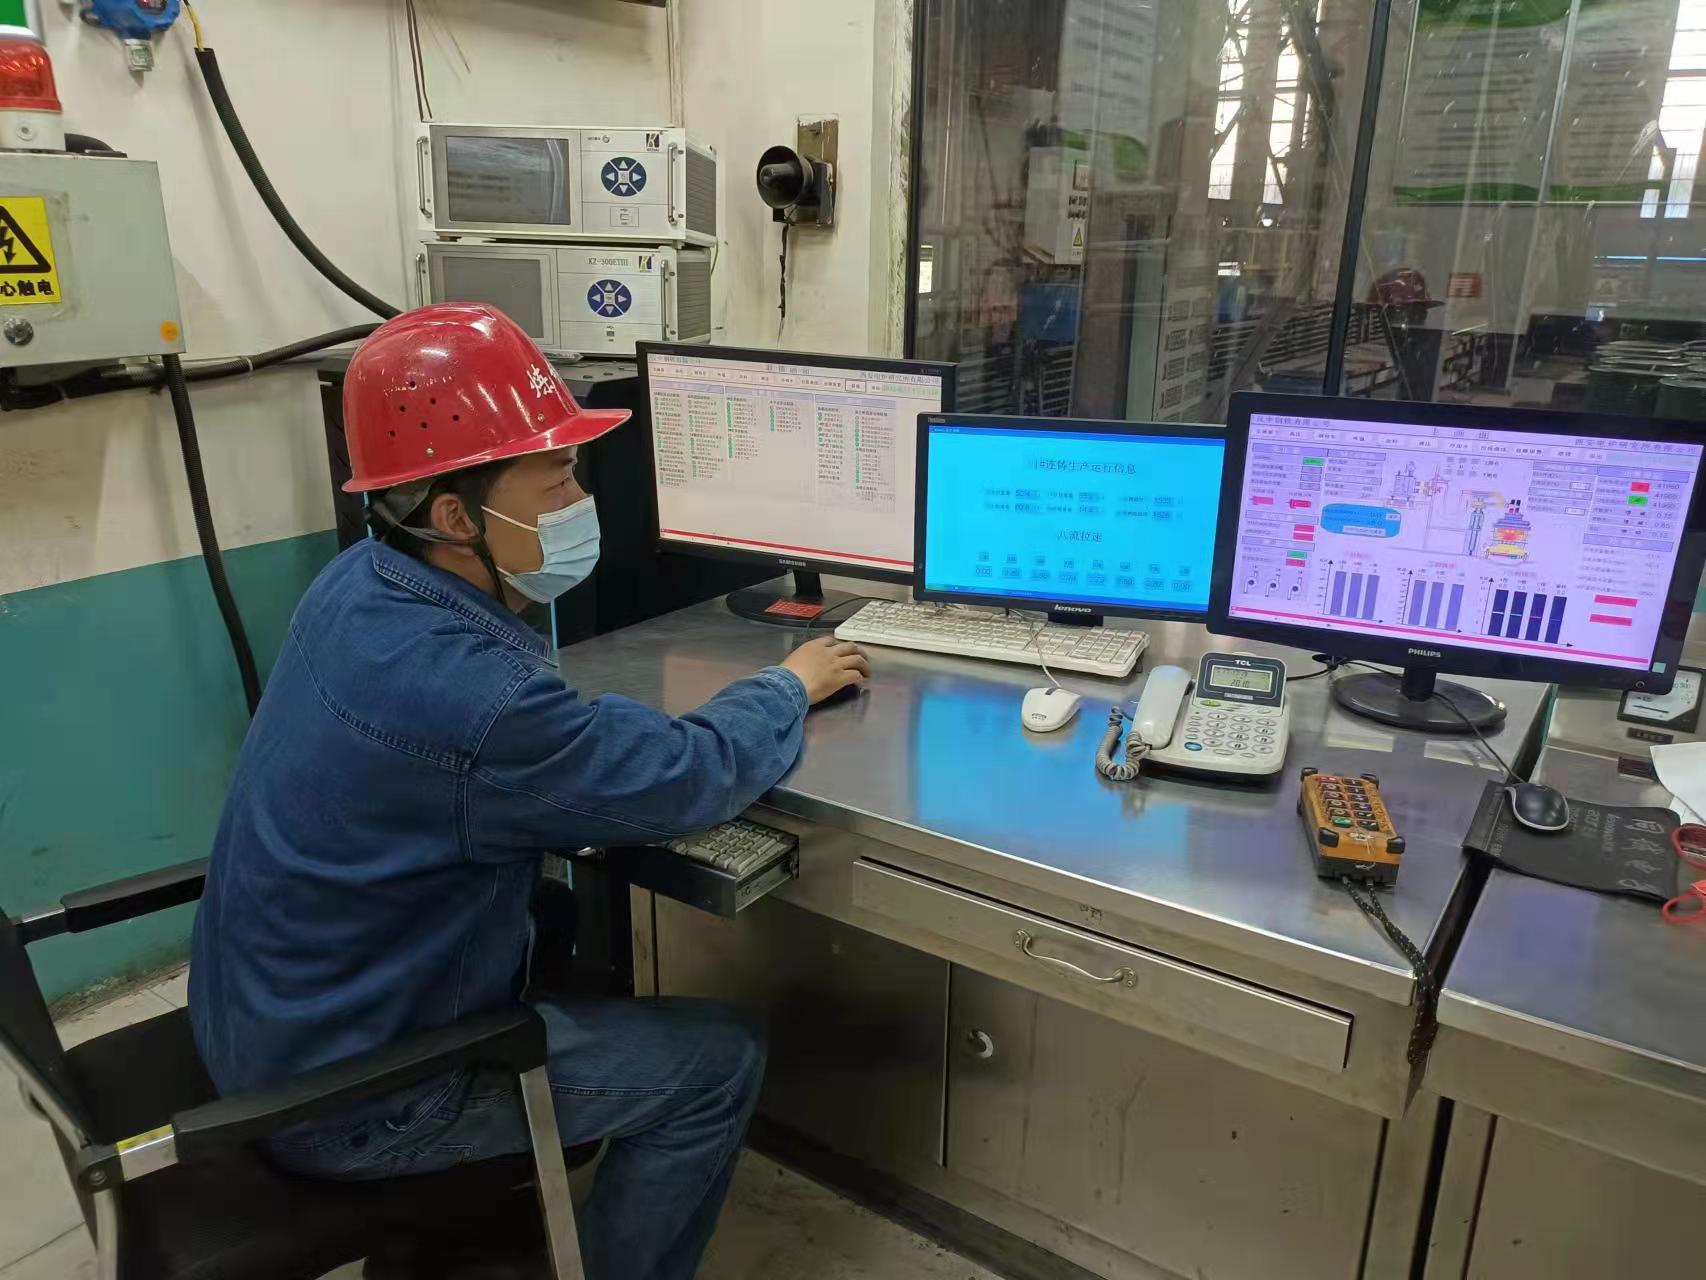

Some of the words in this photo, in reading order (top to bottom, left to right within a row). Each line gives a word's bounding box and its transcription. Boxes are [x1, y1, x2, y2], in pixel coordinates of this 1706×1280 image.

[1054, 603, 1092, 613] lenovo
[1408, 647, 1441, 658] PHILIPS
[1235, 659, 1252, 667] TCL
